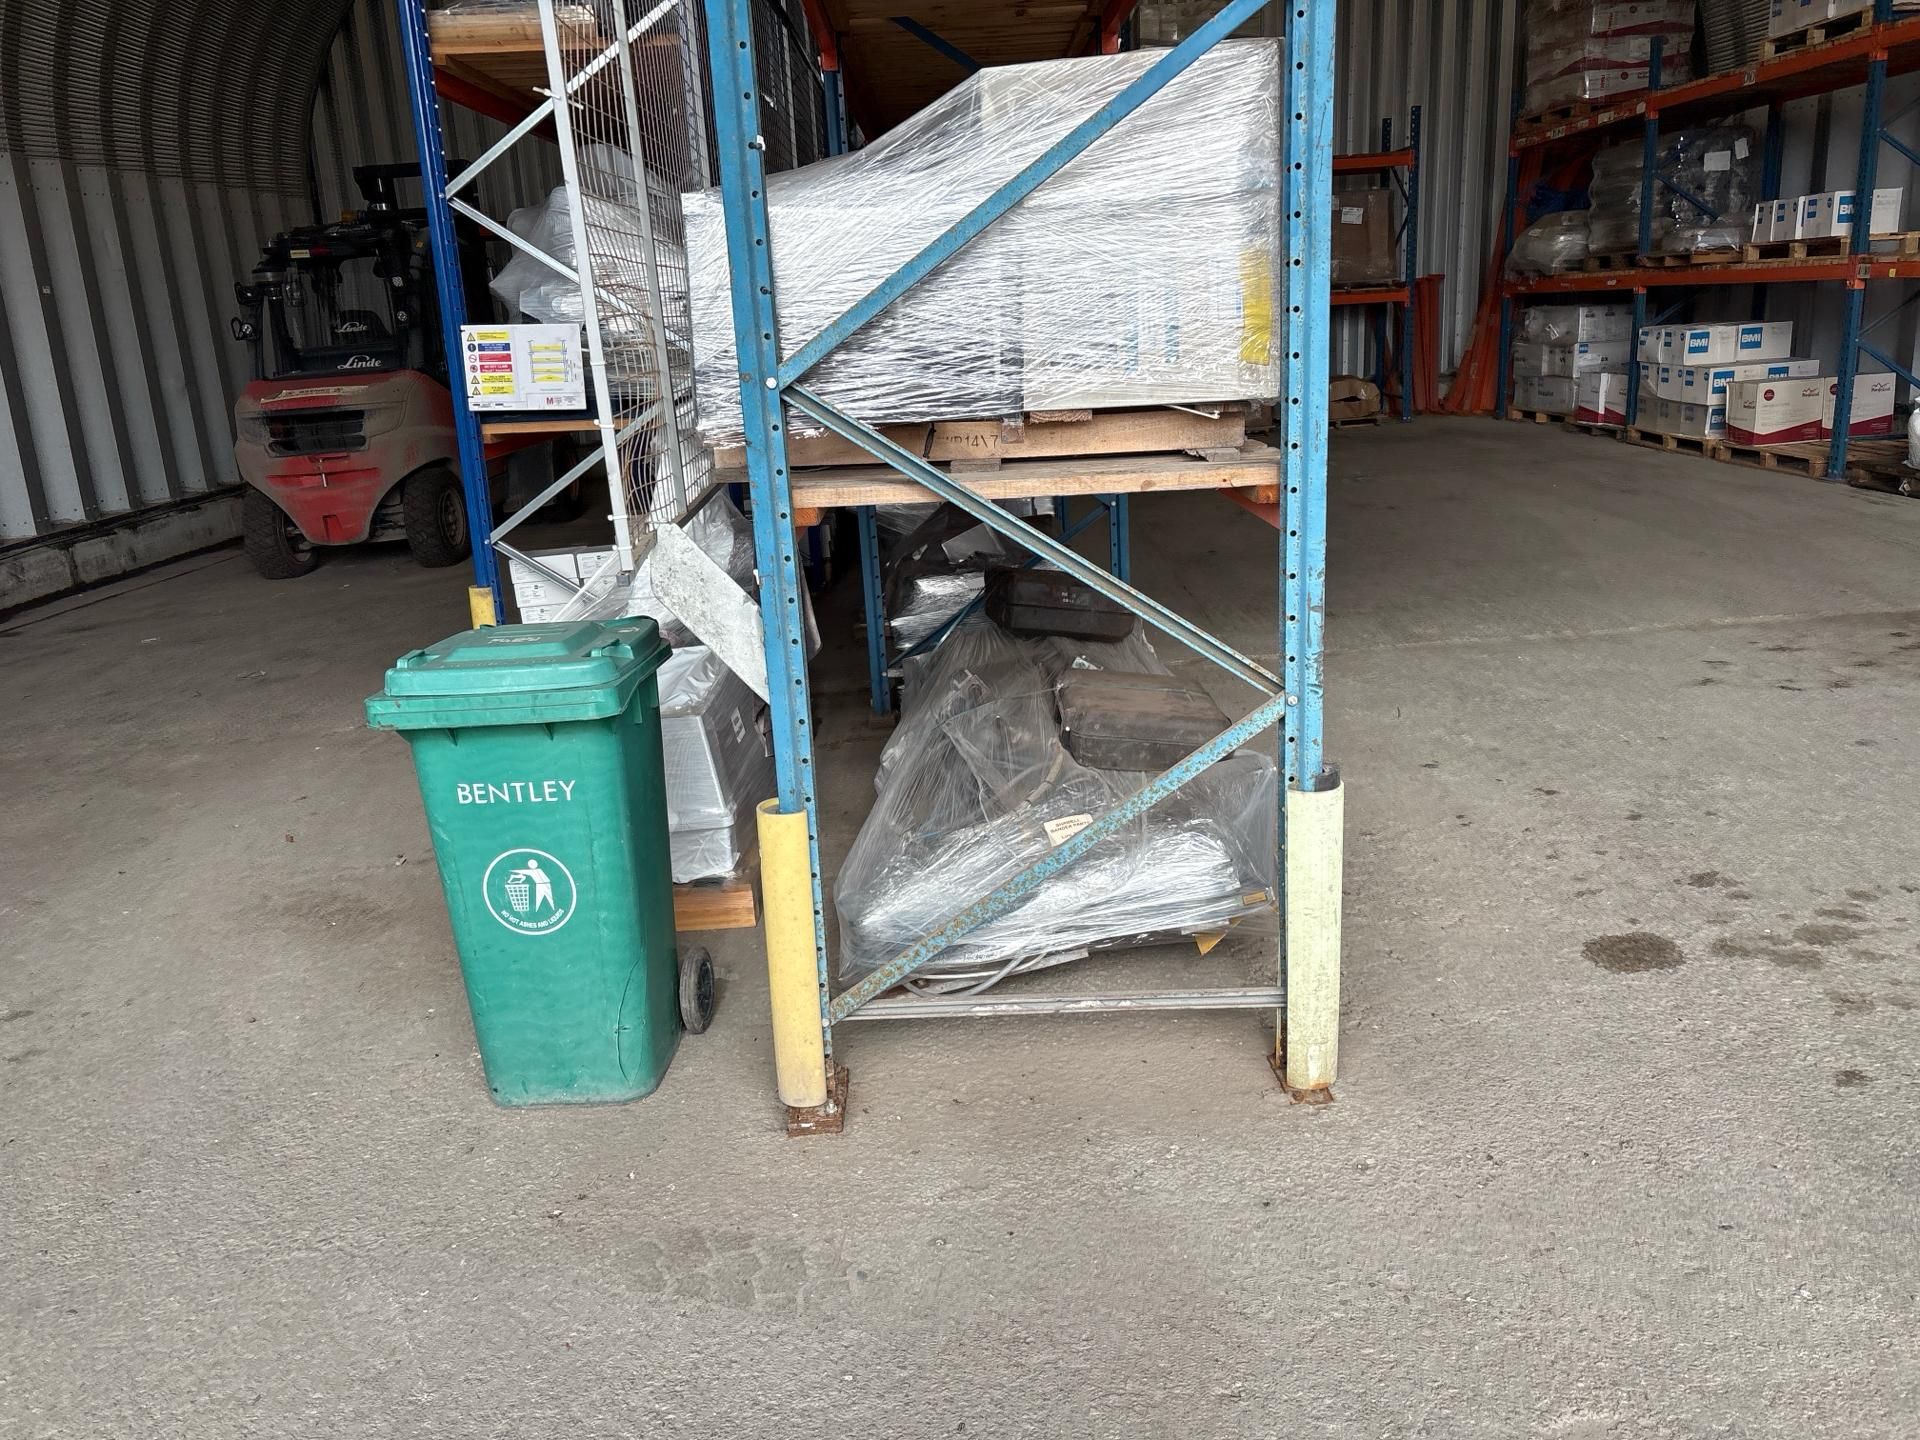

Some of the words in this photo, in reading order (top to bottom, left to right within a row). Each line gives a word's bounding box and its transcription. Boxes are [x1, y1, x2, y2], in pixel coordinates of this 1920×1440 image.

[335, 321, 368, 333] Linde
[1690, 337, 1708, 348] BMI
[1741, 333, 1761, 343] BMI
[337, 354, 382, 370] Linde
[456, 779, 576, 804] BENTLEY
[500, 909, 510, 918] NO
[518, 921, 538, 929] ASHES
[537, 920, 549, 929] AND
